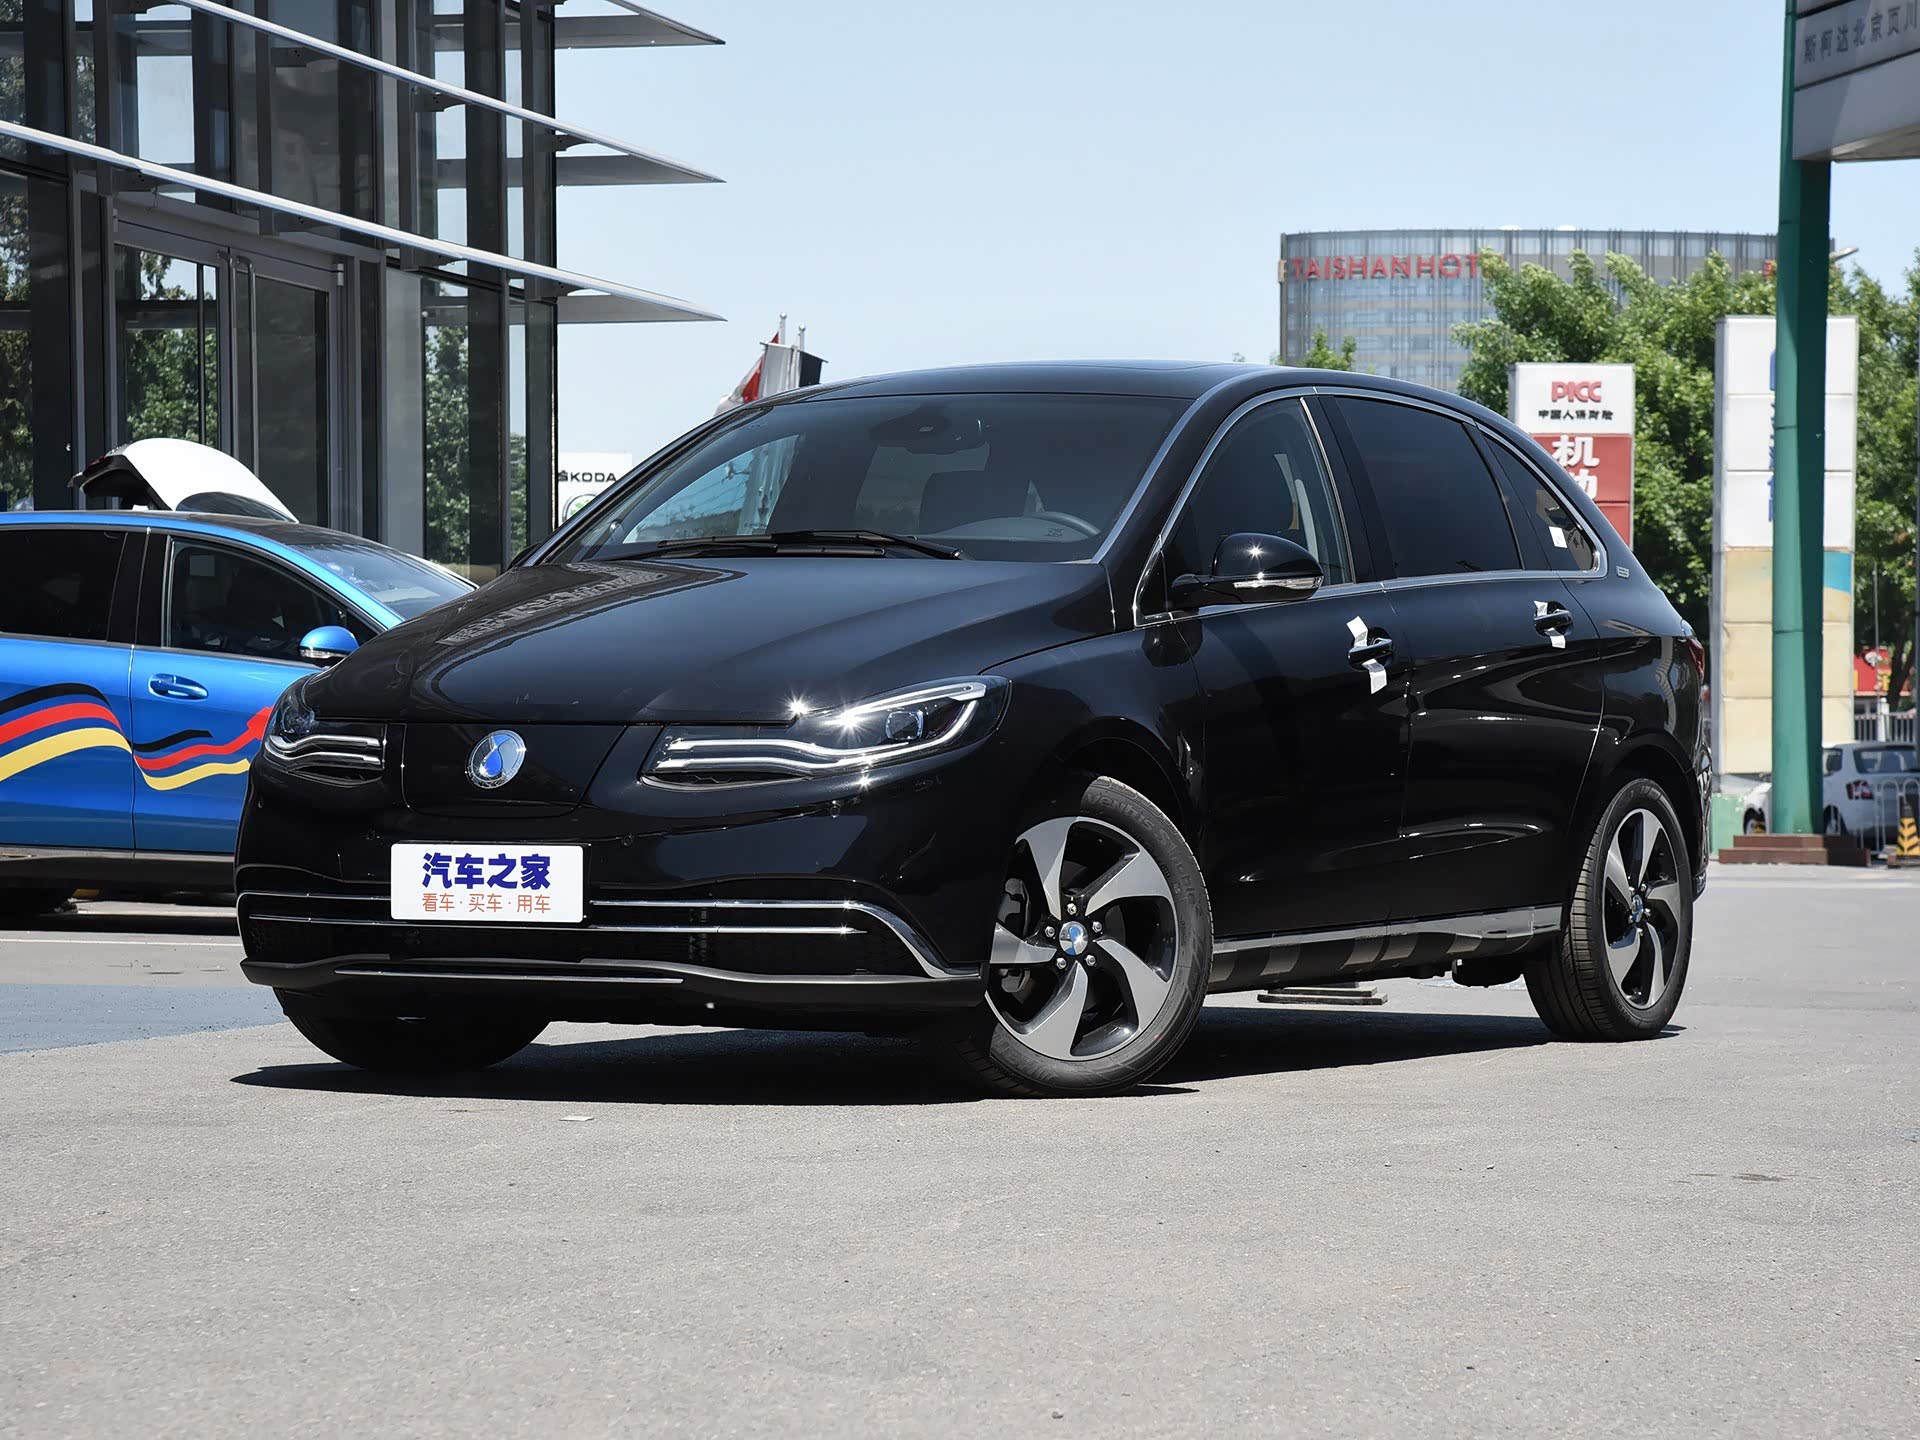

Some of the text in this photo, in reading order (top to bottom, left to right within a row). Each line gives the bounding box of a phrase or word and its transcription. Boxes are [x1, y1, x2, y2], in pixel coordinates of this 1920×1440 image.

[1551, 381, 1602, 403] PICC
[1538, 409, 1613, 421] 中国人保财险
[422, 852, 551, 890] 汽车之家
